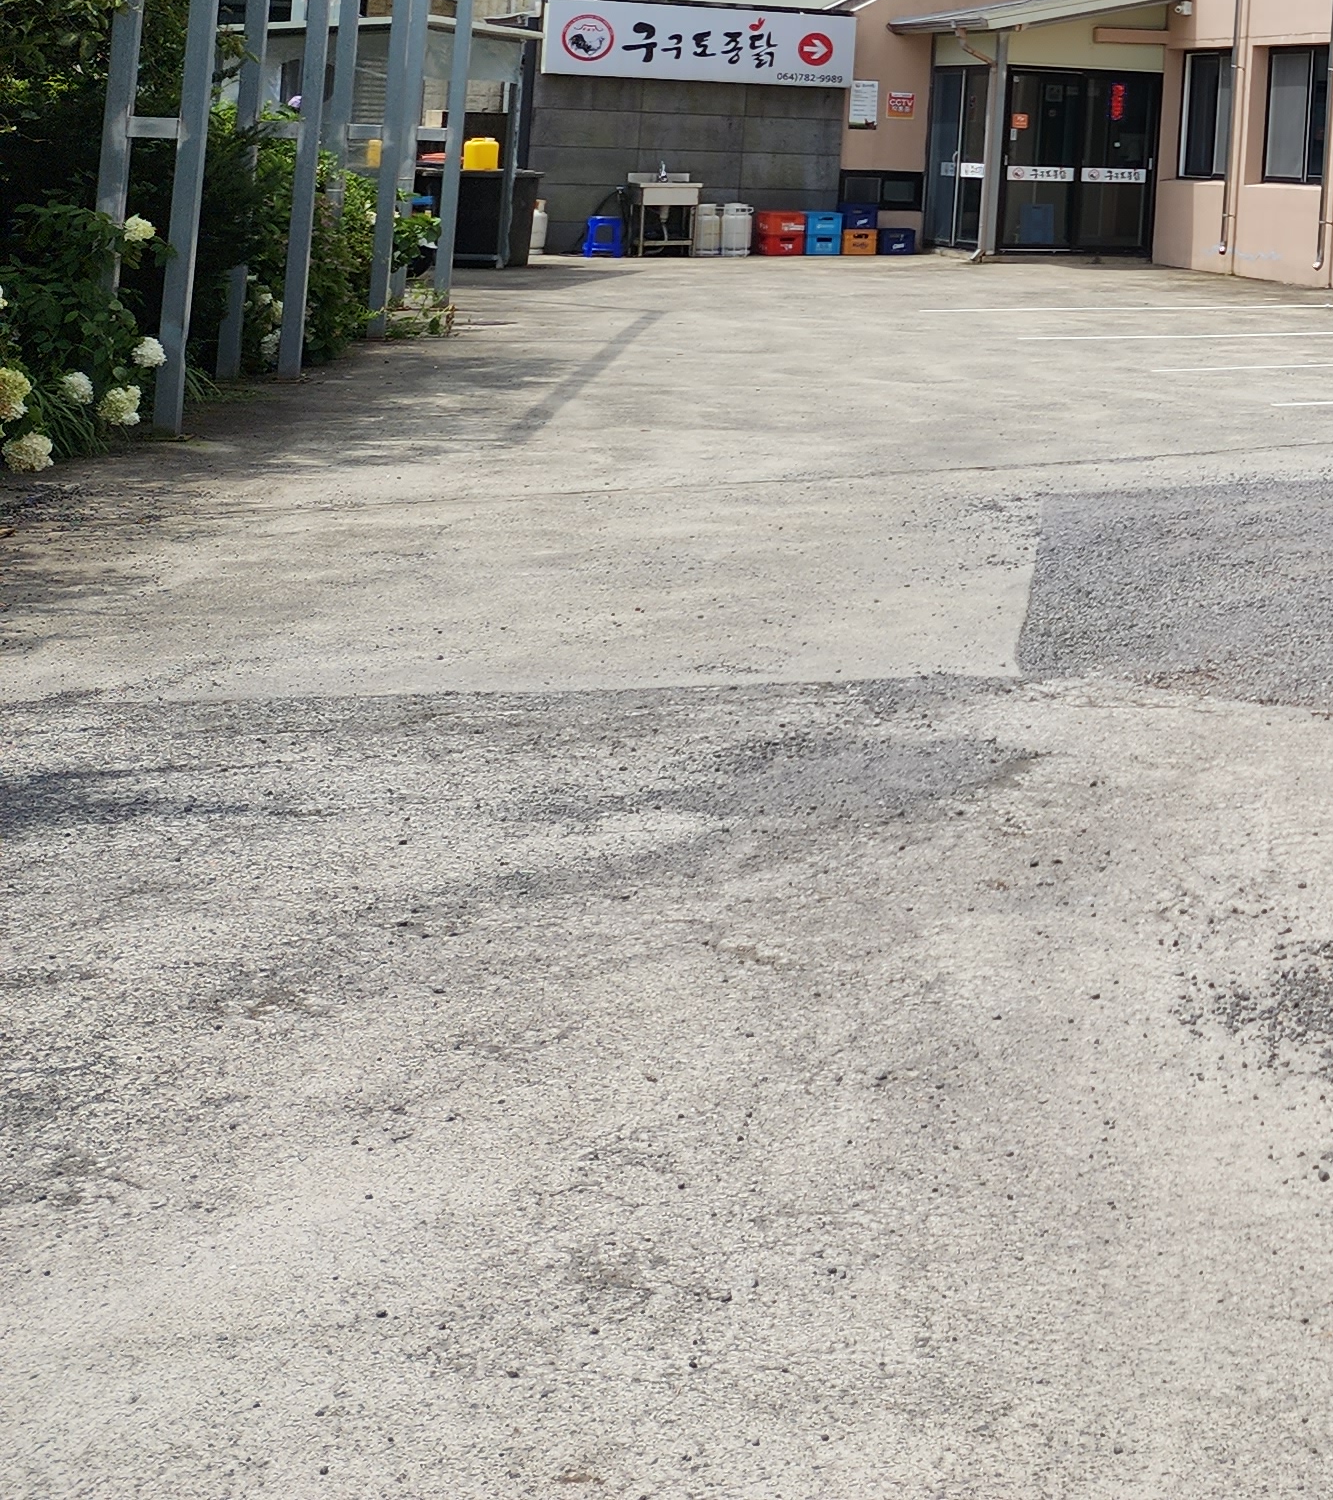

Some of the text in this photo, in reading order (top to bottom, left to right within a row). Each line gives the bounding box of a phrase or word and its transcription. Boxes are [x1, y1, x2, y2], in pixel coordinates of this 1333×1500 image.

[621, 21, 778, 69] 구구토종닭
[776, 72, 843, 84] 064)782-9989
[889, 98, 915, 107] CCTV
